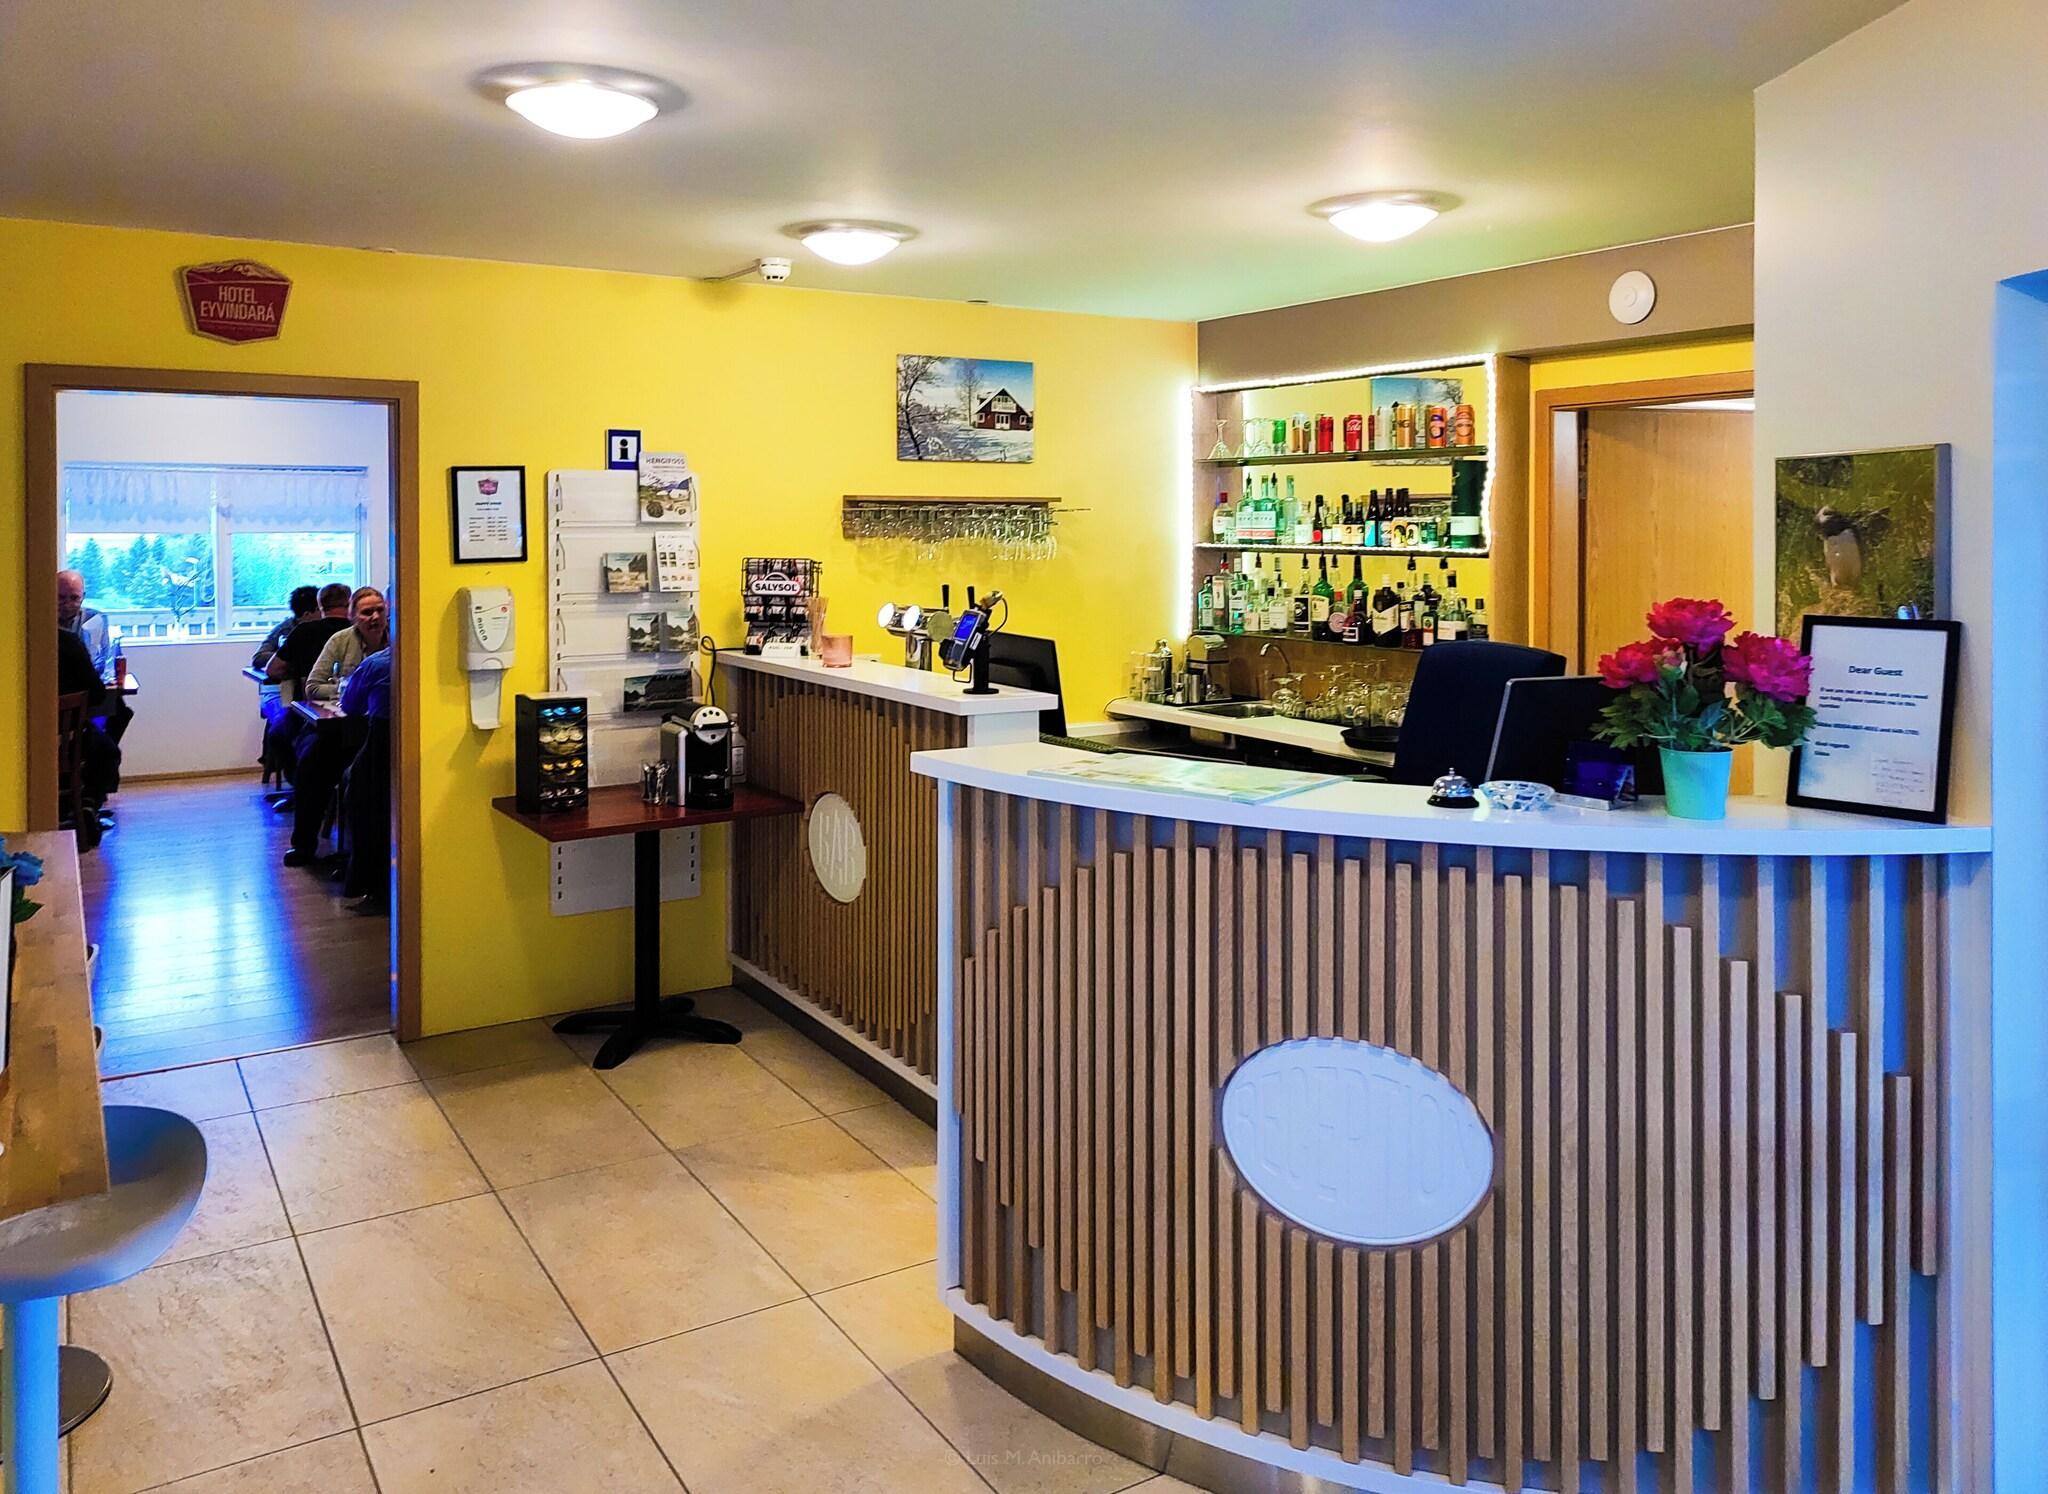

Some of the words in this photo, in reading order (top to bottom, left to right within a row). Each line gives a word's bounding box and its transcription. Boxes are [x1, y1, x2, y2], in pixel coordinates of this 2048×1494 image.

[218, 286, 258, 304] HOTEL
[200, 302, 275, 322] EYVINDARÁ
[755, 583, 797, 592] SALYSOL
[1848, 665, 1872, 675] Dear
[1873, 667, 1904, 677] Guest
[818, 809, 857, 886] BAR
